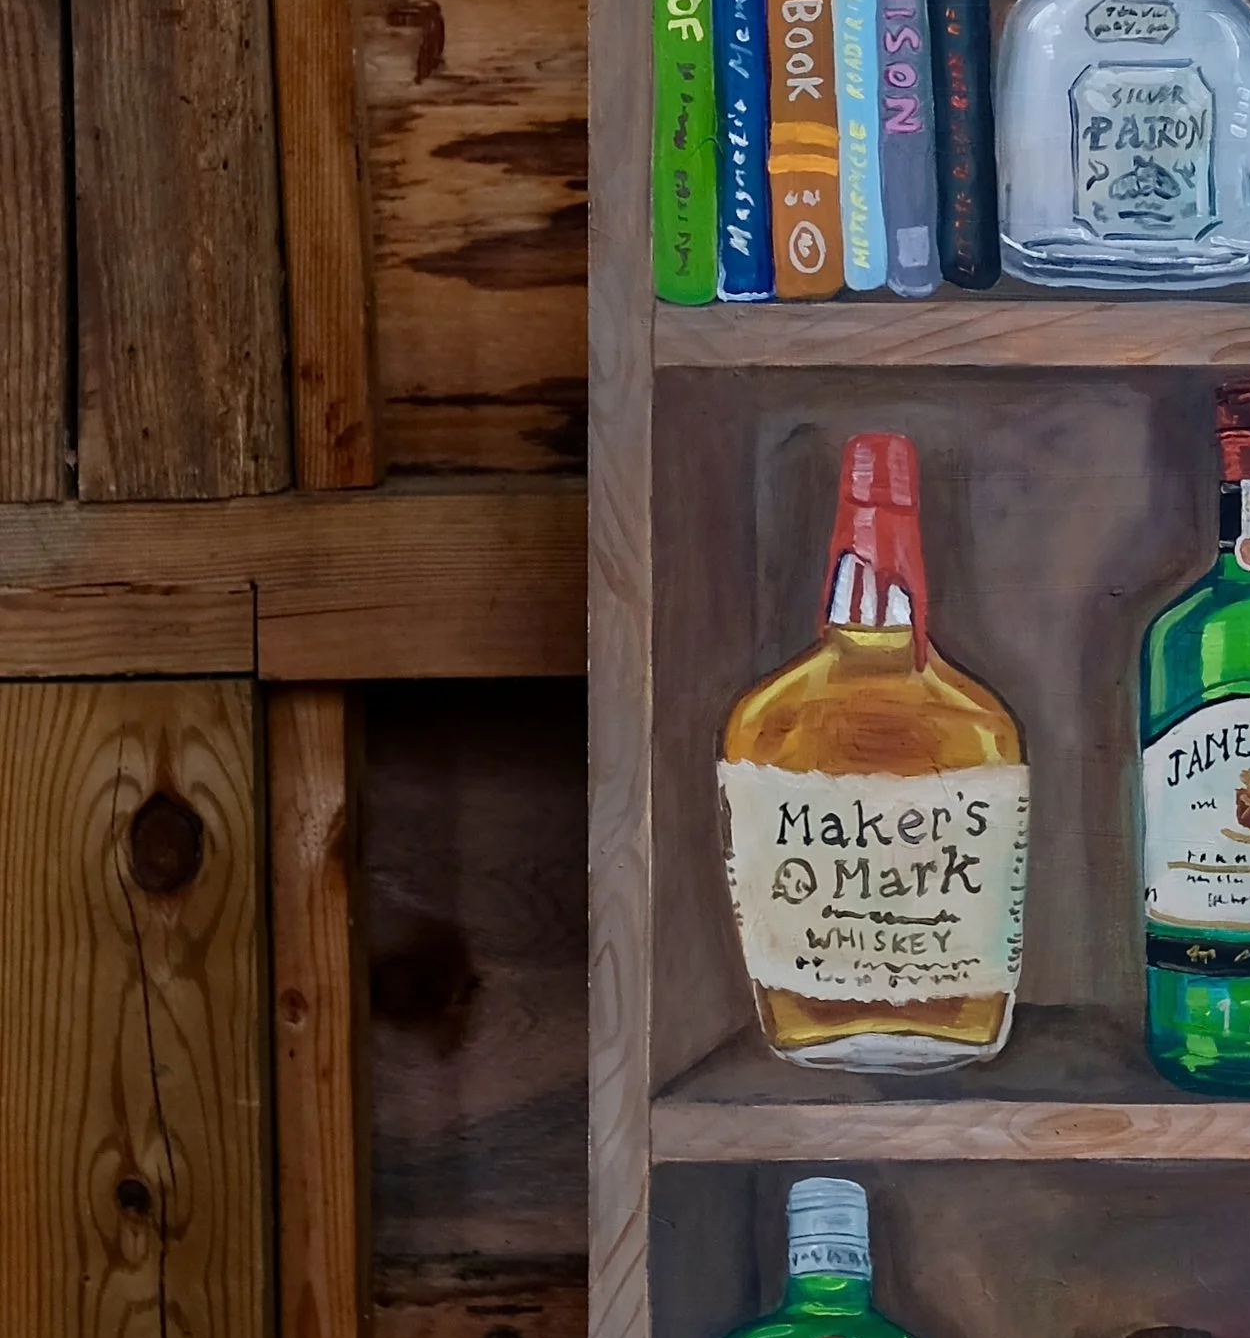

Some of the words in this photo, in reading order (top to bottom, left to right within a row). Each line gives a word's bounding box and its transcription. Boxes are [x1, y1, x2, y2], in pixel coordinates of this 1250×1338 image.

[1083, 109, 1208, 152] PATRON
[776, 791, 990, 848] Maker's
[832, 845, 982, 899] Mark
[806, 927, 951, 955] WHISKEY
